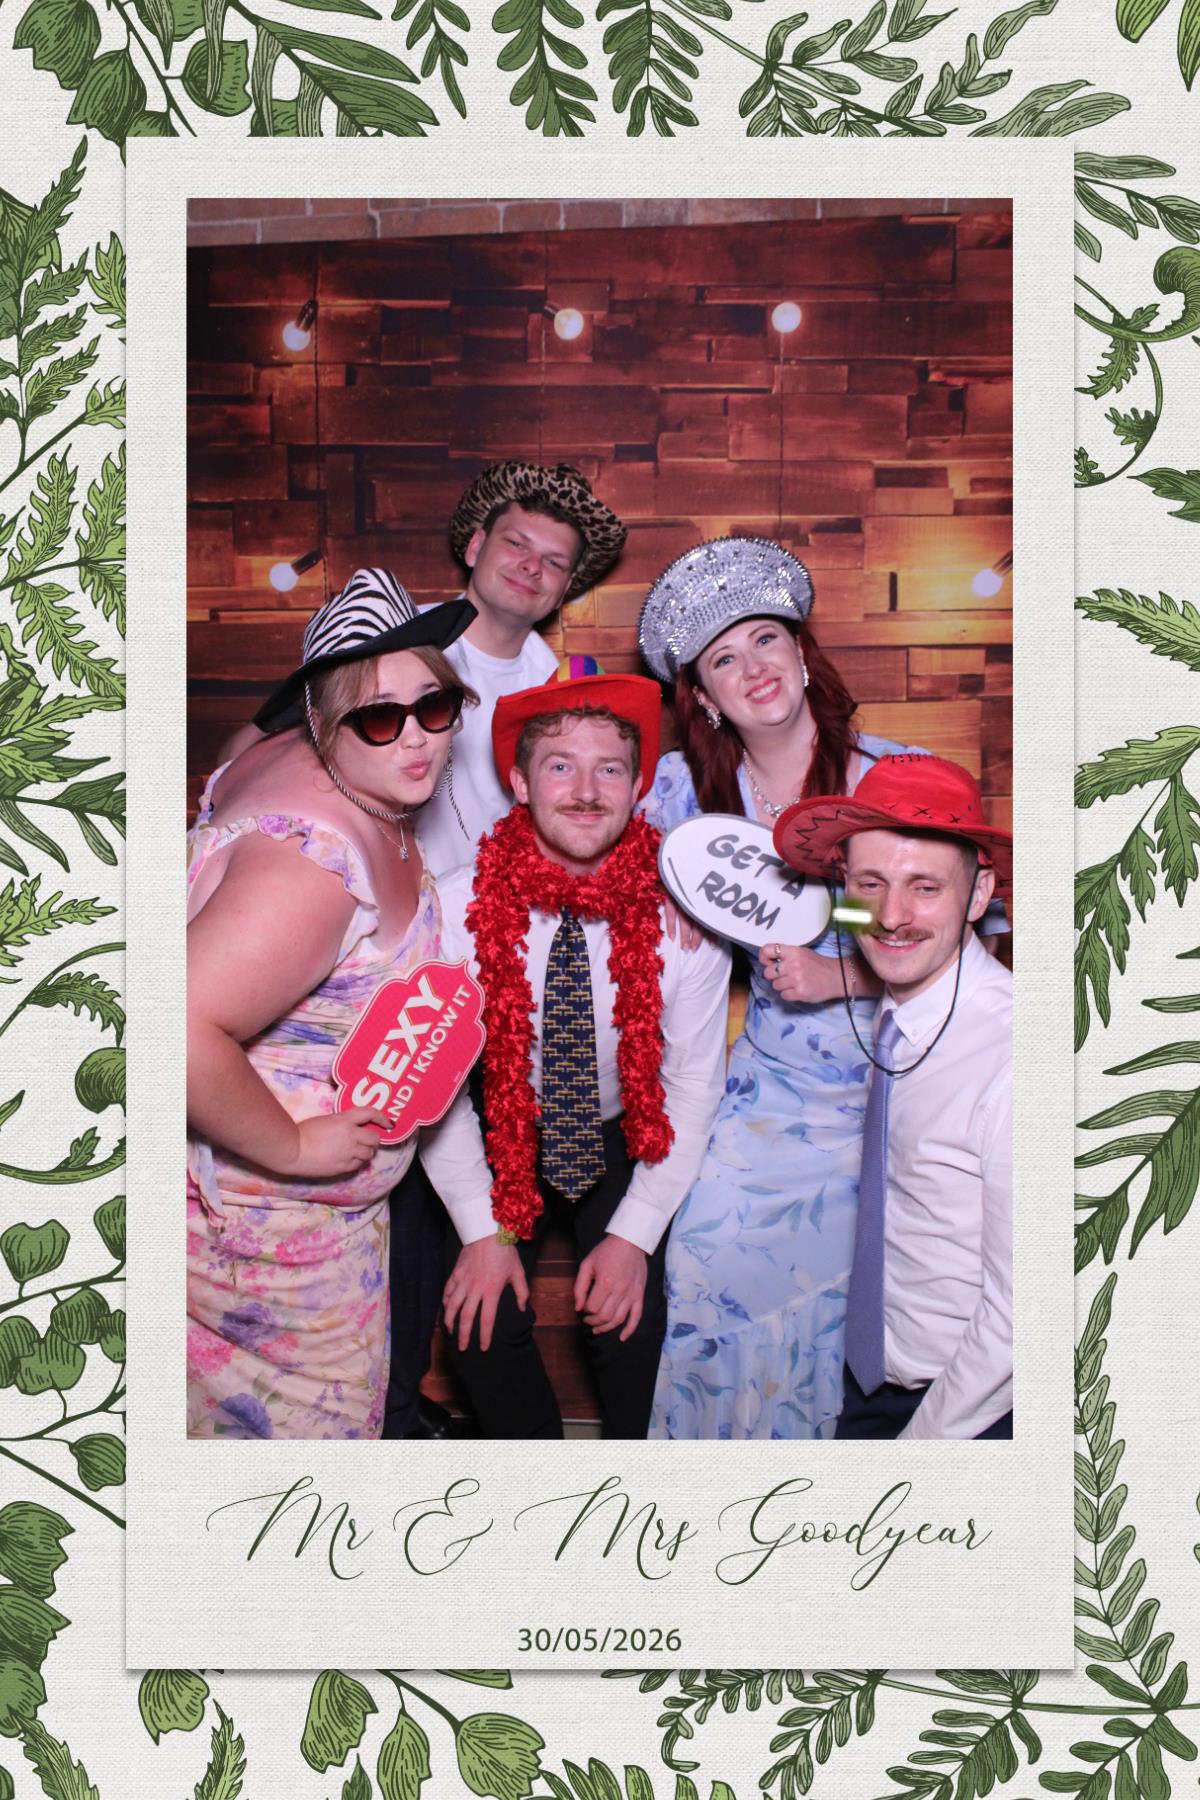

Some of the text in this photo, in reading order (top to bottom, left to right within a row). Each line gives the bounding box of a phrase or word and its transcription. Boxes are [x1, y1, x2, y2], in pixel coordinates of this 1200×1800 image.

[696, 870, 781, 930] ROOM
[706, 834, 807, 900] GET A
[352, 973, 444, 1111] SEXY
[406, 1073, 420, 1084] I
[413, 1007, 459, 1074] KNOW
[452, 984, 472, 1007] IT
